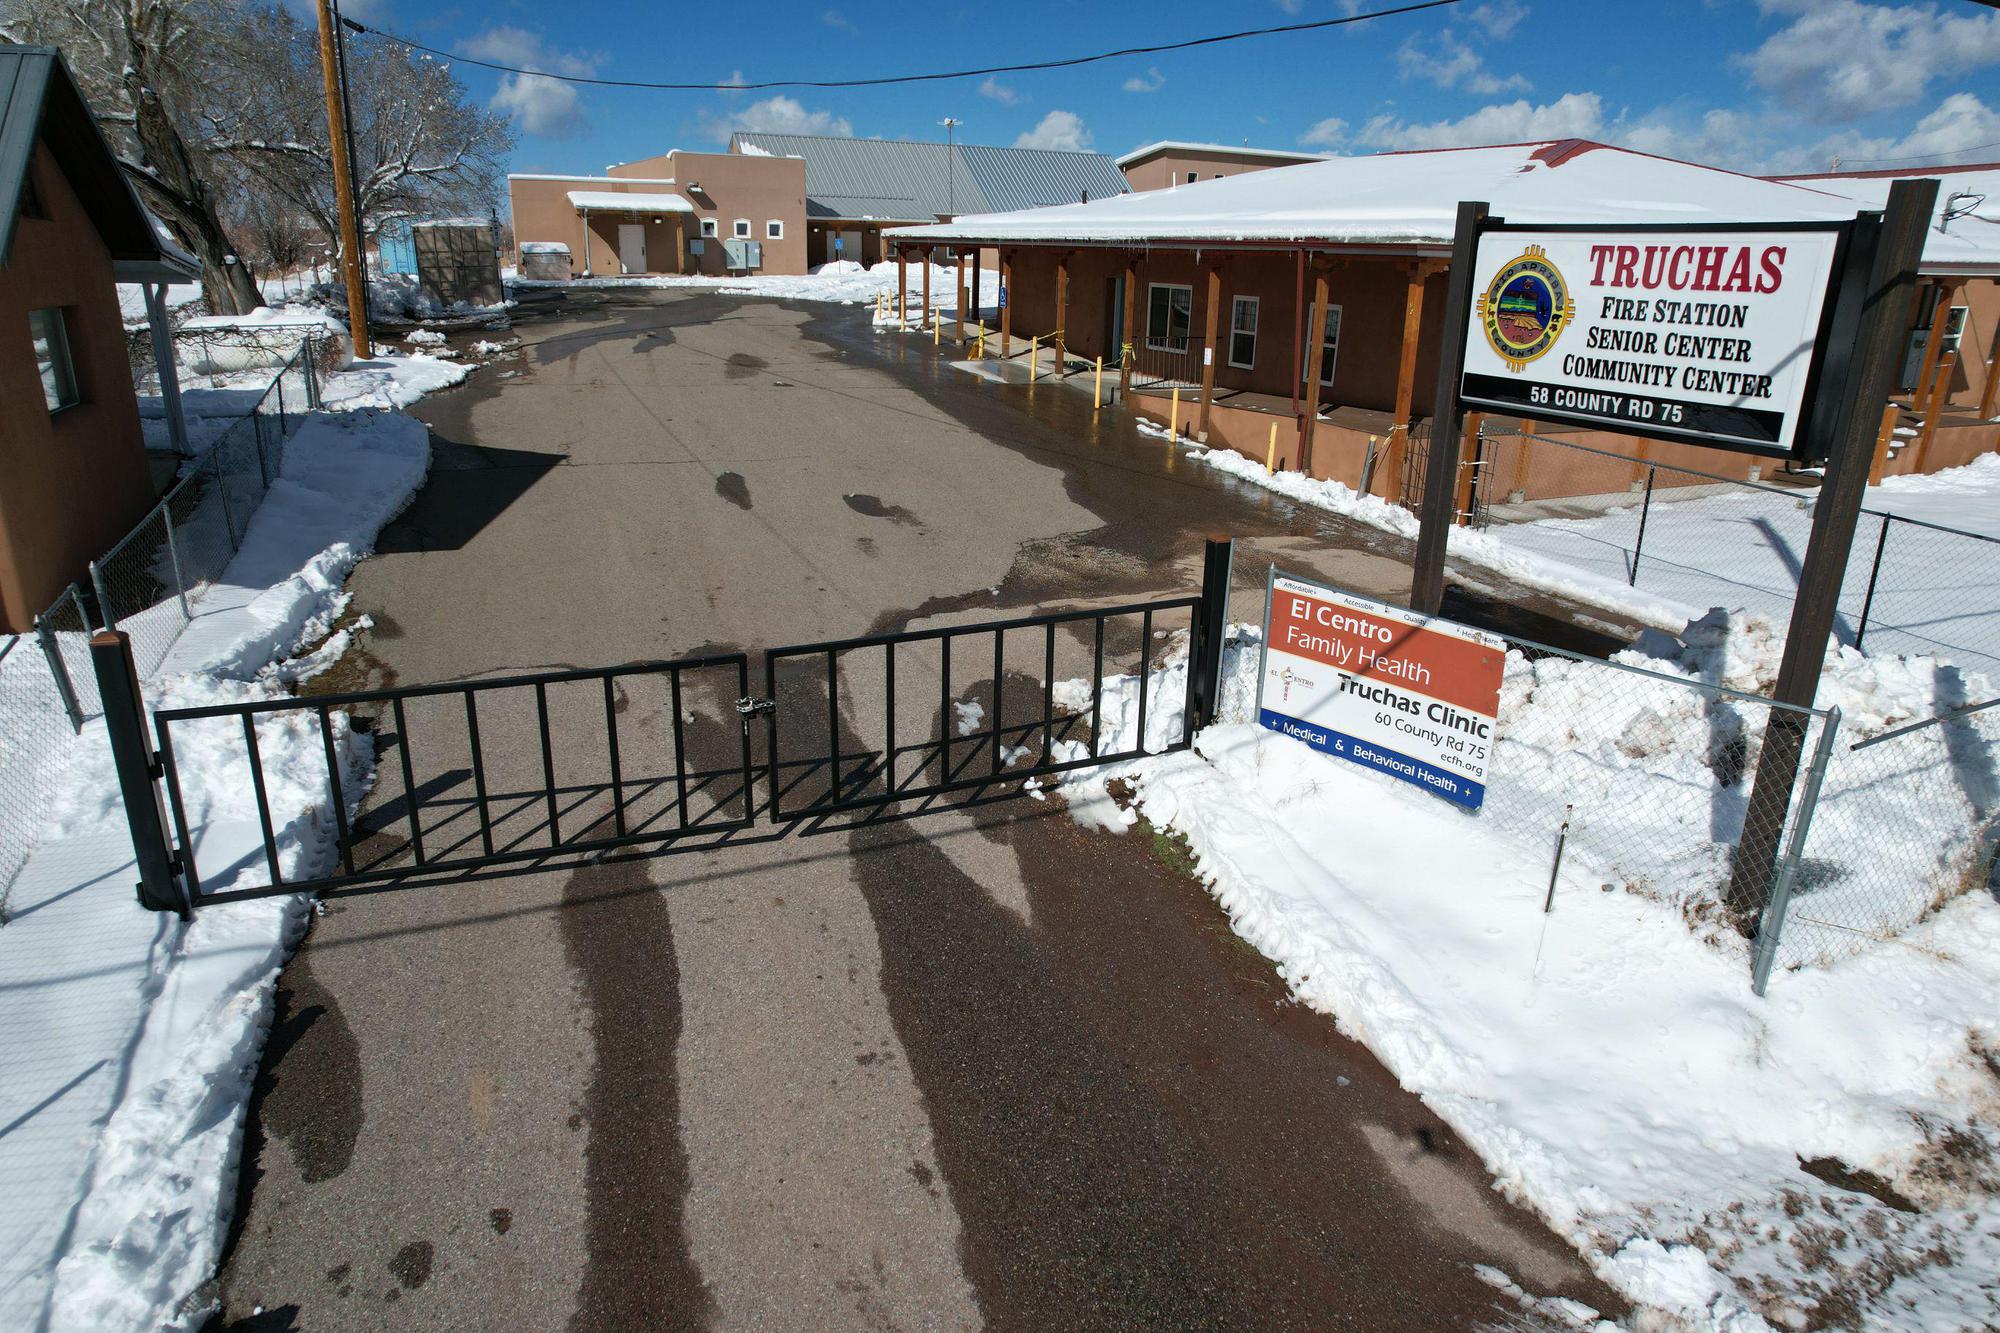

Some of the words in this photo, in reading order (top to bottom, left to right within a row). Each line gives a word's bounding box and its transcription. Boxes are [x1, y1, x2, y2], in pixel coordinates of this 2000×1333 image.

[1494, 269, 1515, 292] RIO
[1520, 263, 1563, 301] ARRIBA
[1590, 245, 1787, 294] TRUCHAS
[1600, 297, 1648, 321] FIRE
[1652, 299, 1749, 328] STATION
[1494, 337, 1545, 358] COUNTY
[1586, 326, 1657, 354] SENIOR
[1664, 332, 1751, 363] CENTER
[1562, 354, 1677, 388] COMMUNITY
[1682, 367, 1772, 398] CENTER
[1530, 386, 1548, 403] 58
[1554, 391, 1622, 414] COUNTY
[1630, 399, 1654, 419] RD
[1661, 403, 1683, 423] 75
[1283, 582, 1314, 595] Affordable
[1343, 598, 1375, 611] Accessible
[1403, 614, 1427, 626] Quality
[1291, 598, 1311, 620] El
[1316, 606, 1393, 643] Centro
[1287, 625, 1353, 665] Family
[1358, 649, 1431, 685] Health
[1337, 672, 1421, 716] Truchas
[1427, 703, 1490, 739] Clinic
[1283, 721, 1327, 745] Medical
[1335, 740, 1345, 752] &
[1354, 746, 1415, 777] Behavioral
[1417, 768, 1458, 794] Health
[1375, 711, 1392, 726] 60
[1395, 718, 1444, 747] County
[1446, 735, 1464, 752] Rd
[1468, 744, 1486, 760] 75
[1440, 752, 1484, 777] ecfh.org
